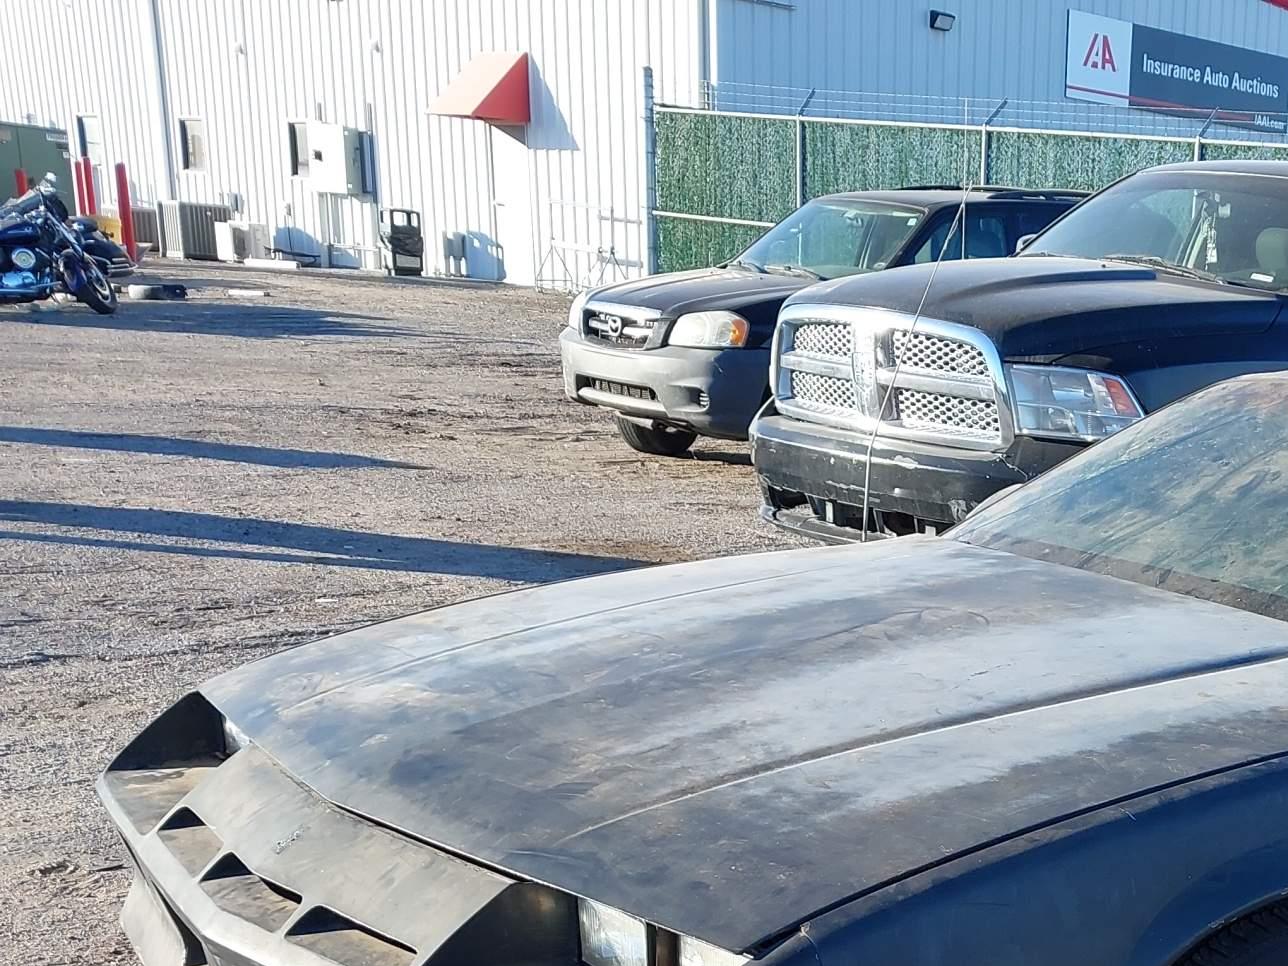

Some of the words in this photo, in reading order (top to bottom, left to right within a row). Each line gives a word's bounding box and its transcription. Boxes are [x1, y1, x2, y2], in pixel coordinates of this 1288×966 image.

[1142, 53, 1201, 83] Insurance
[1203, 67, 1229, 89] Auto
[1231, 72, 1279, 98] Auctions
